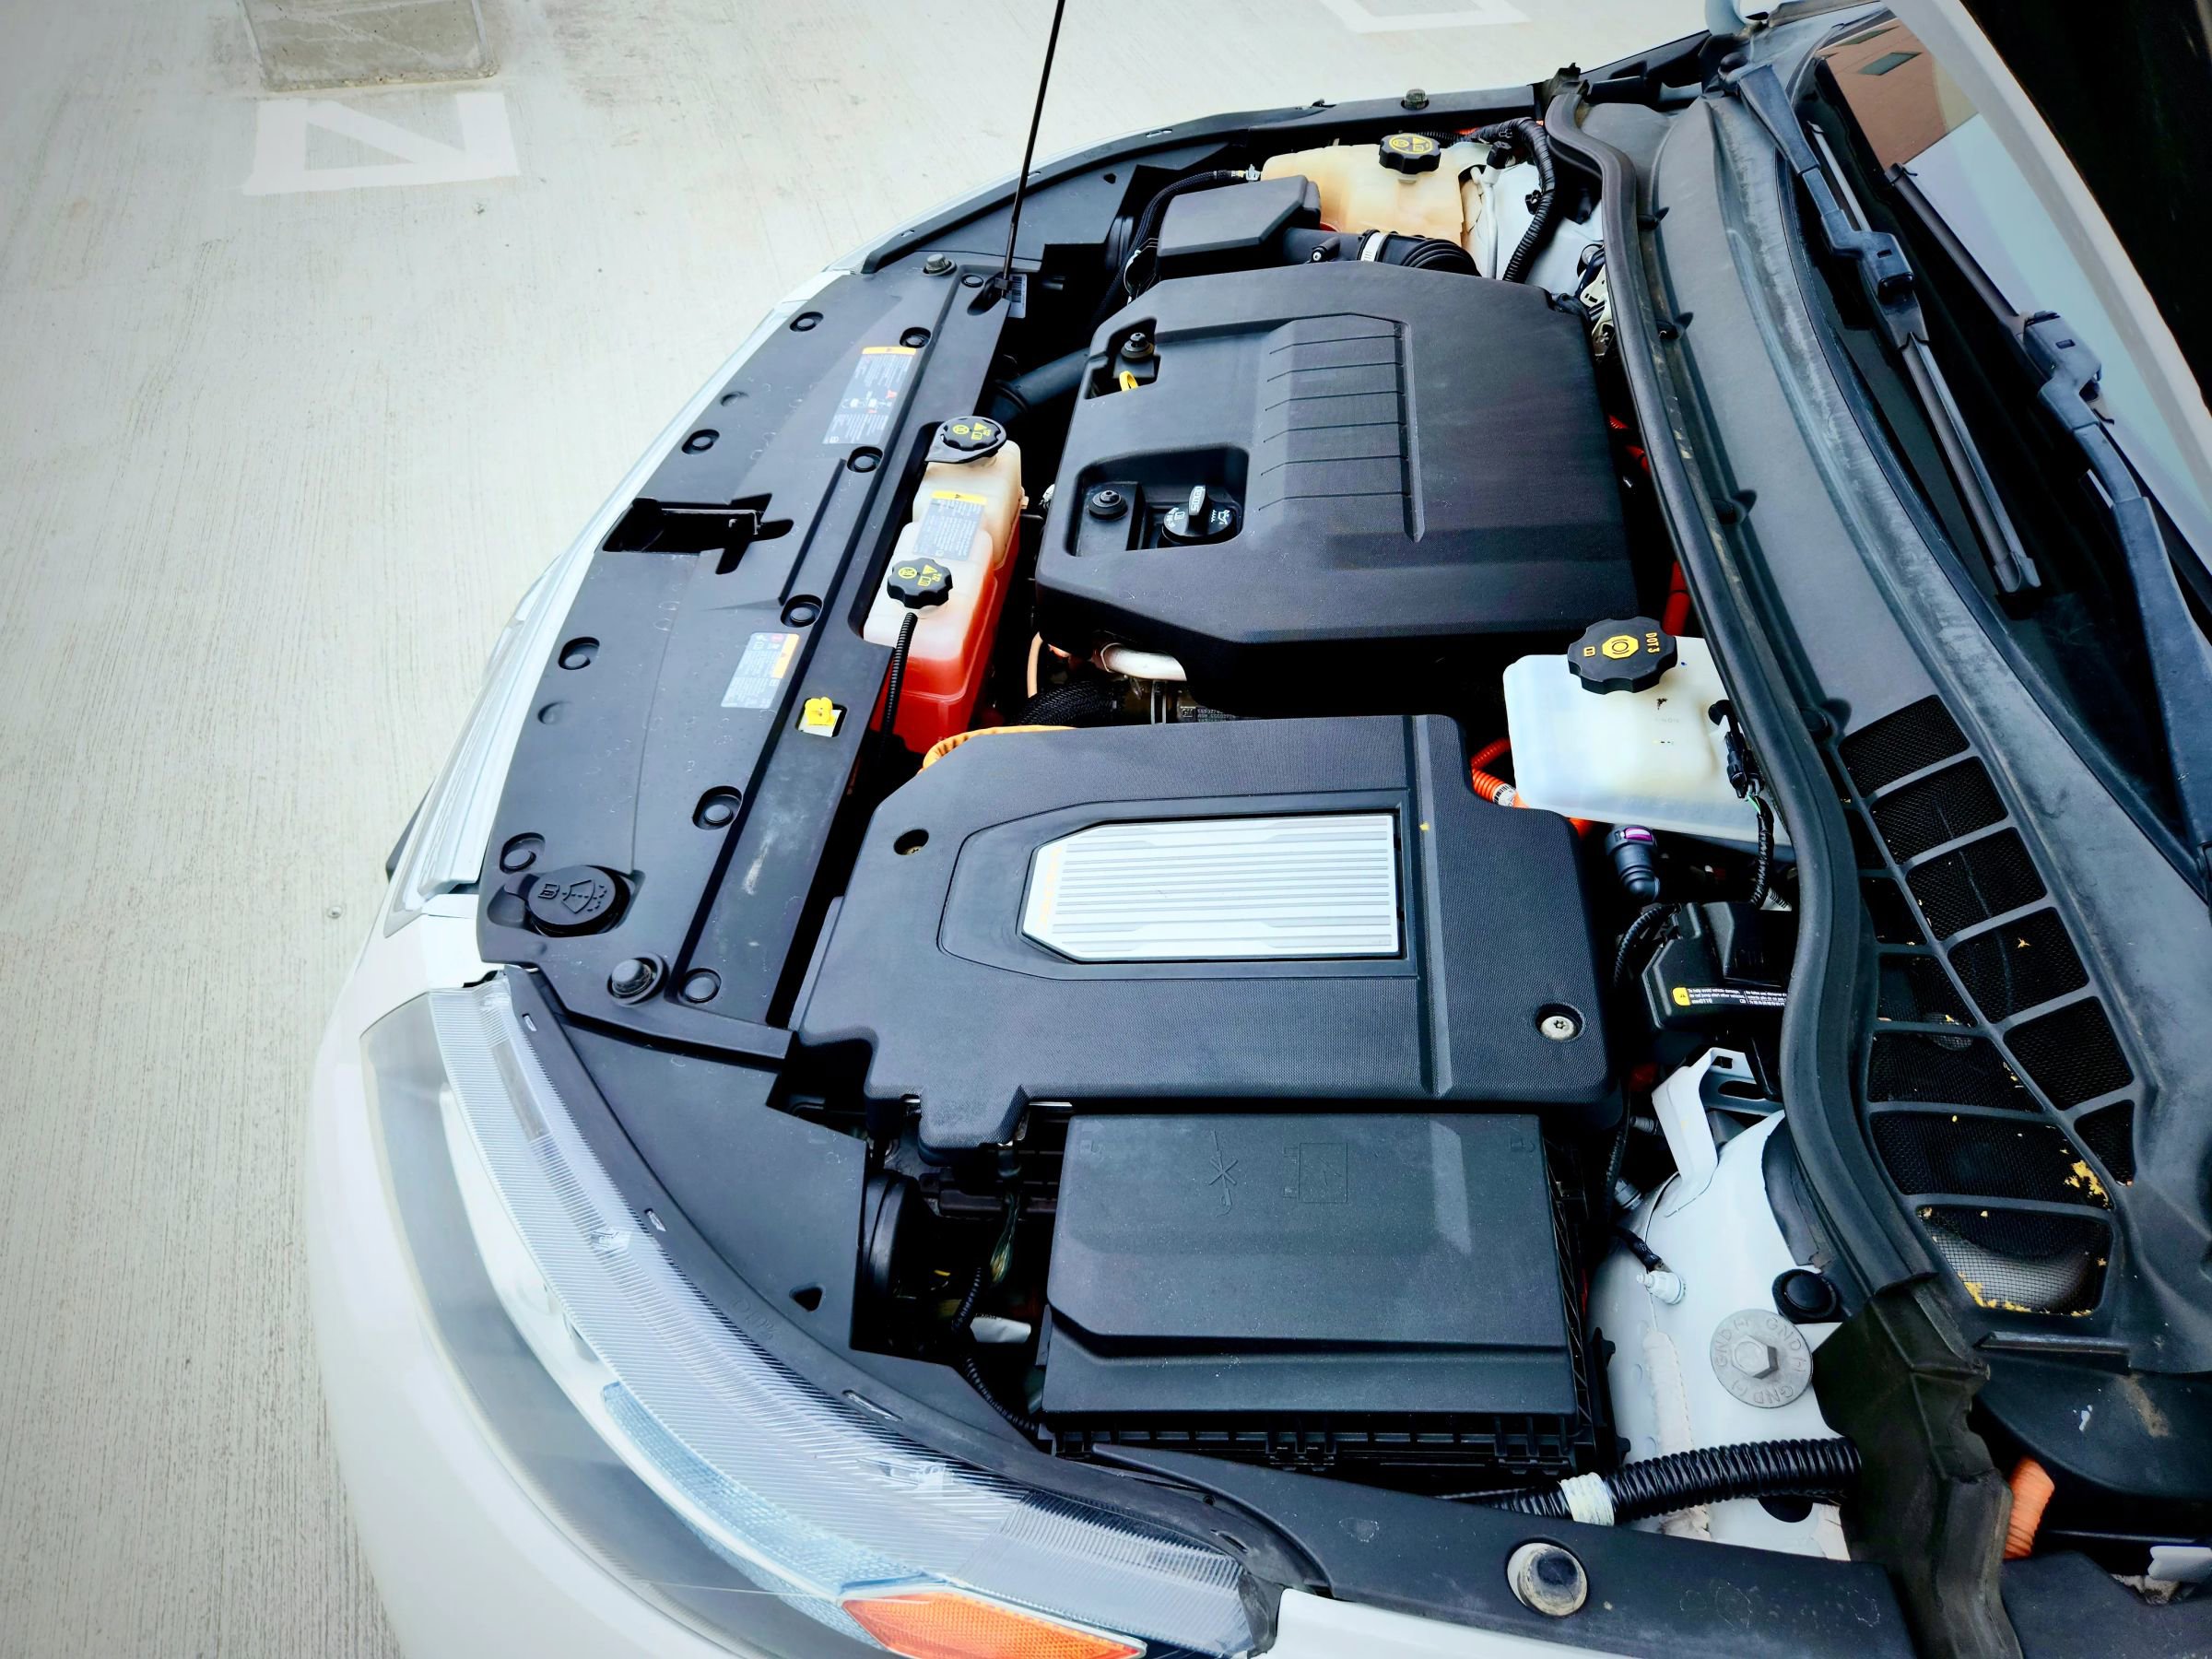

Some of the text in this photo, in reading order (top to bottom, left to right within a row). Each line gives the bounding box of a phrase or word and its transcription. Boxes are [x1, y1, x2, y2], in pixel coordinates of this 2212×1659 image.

[1645, 632, 1659, 646] DOT
[1766, 1317, 1802, 1351] GND
[1714, 1329, 1732, 1367] GND
[1753, 1384, 1794, 1405] GND
